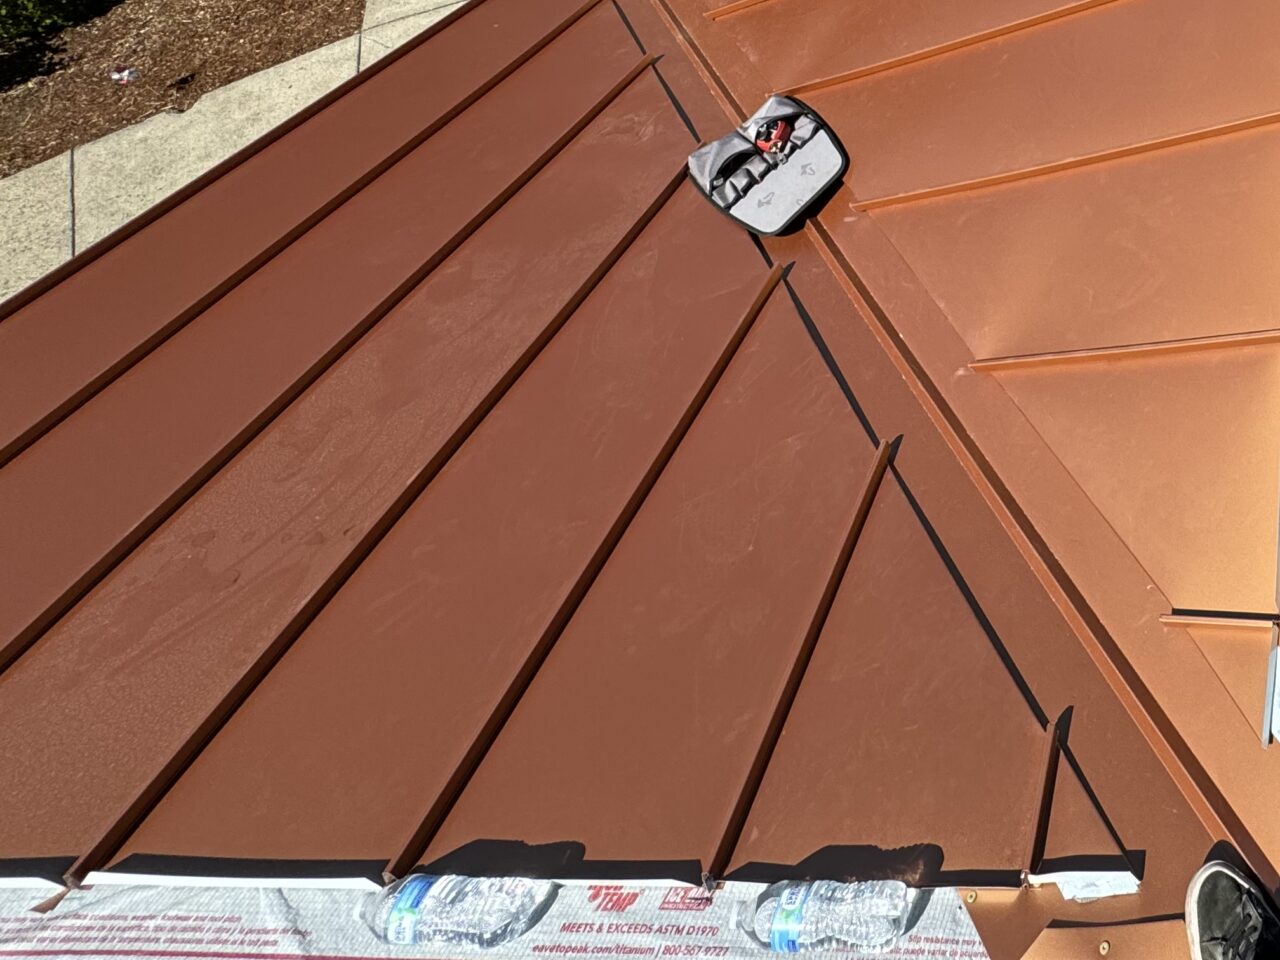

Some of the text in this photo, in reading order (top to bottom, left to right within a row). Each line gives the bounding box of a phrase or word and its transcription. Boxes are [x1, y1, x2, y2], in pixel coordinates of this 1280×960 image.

[594, 893, 640, 912] TEMP
[559, 922, 719, 937] MEETS & EXCEEDS ASTM D1970
